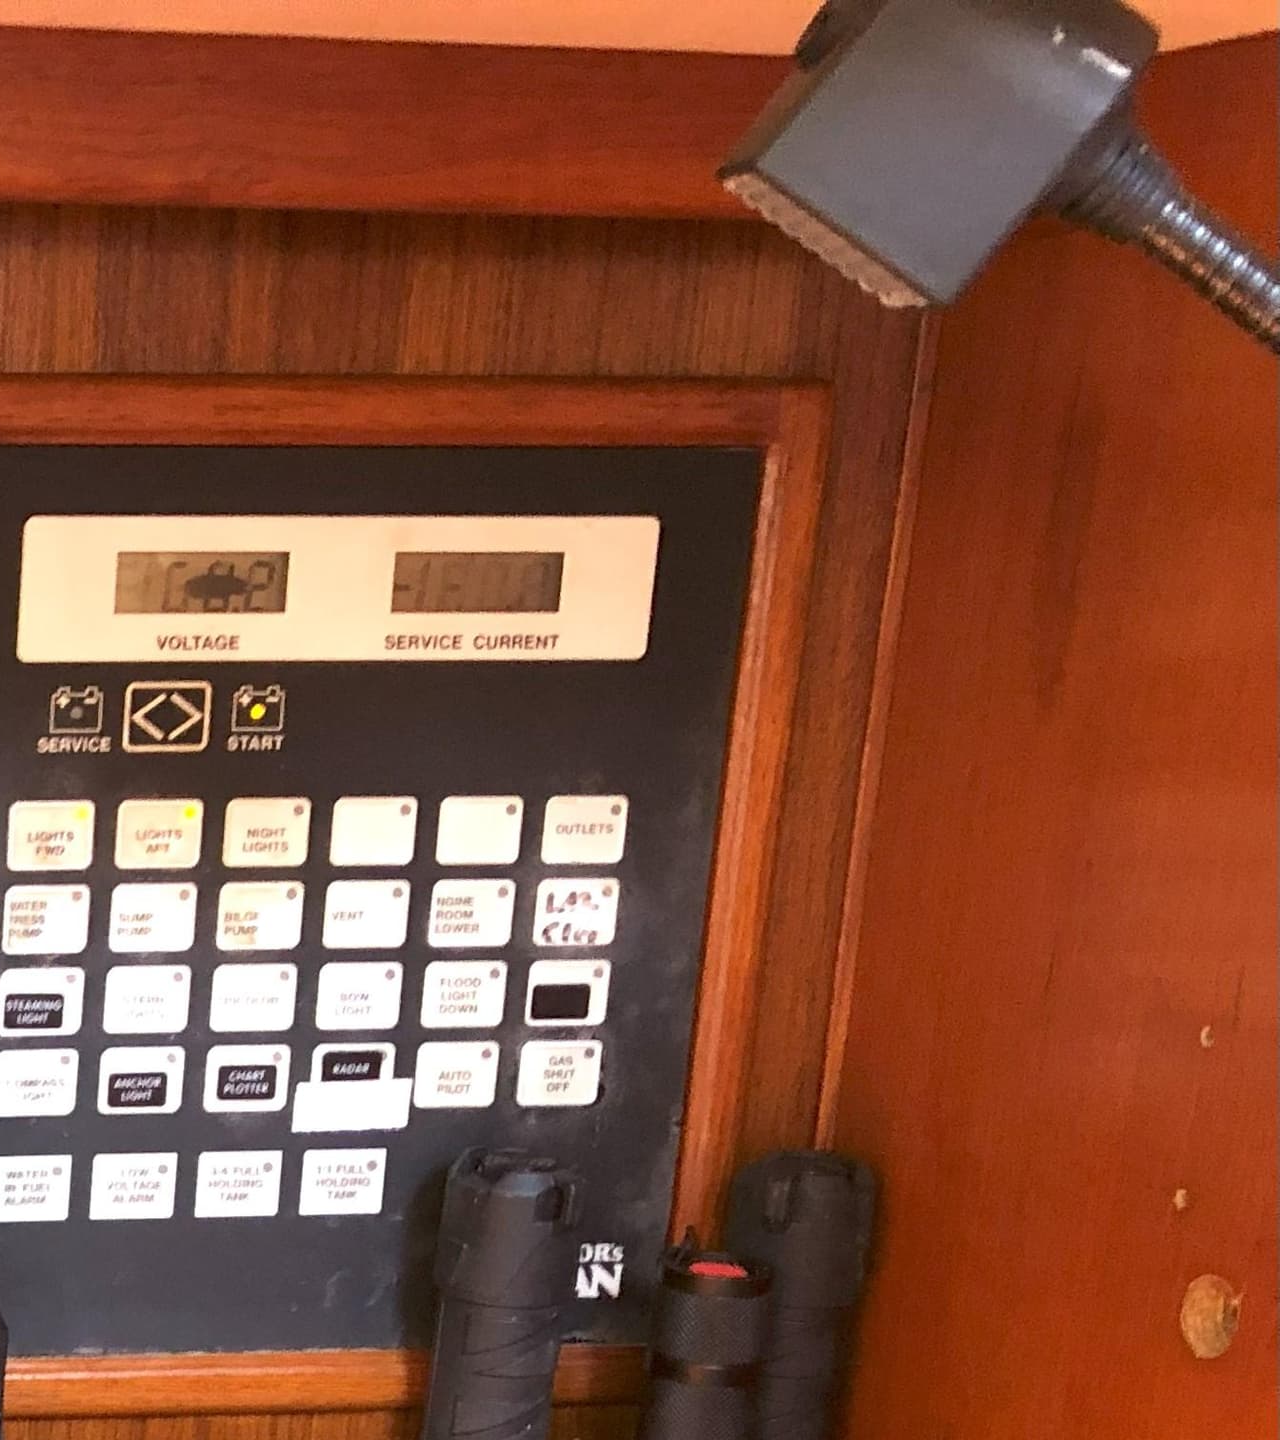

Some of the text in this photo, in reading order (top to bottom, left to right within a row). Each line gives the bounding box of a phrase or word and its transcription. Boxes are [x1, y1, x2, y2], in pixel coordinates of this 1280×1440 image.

[156, 634, 241, 651] VOLTAGE
[384, 634, 560, 651] SERVICE CURRENT
[37, 736, 112, 753] SERVICE
[227, 735, 285, 751] START
[246, 828, 287, 839] NIGHT
[555, 822, 614, 835] OUTLETS
[136, 829, 183, 841] LIGHTS
[242, 841, 290, 853] LIGHTS
[332, 911, 364, 921] VENT
[436, 909, 474, 920] ROOM
[434, 923, 480, 934] LOWER
[440, 977, 481, 988] FLOOD
[441, 991, 477, 1001] LIGHT
[439, 1004, 478, 1014] DOWN
[16, 1012, 49, 1025] LIGHT
[549, 1055, 573, 1067] GAS
[331, 1062, 370, 1075] RADAR
[544, 1068, 575, 1080] SHUT
[228, 1069, 266, 1082] CHART
[438, 1071, 472, 1082] AUTO
[114, 1076, 162, 1090] ANCHOR
[223, 1081, 269, 1095] PLOTTER
[546, 1081, 570, 1093] OFF
[437, 1084, 472, 1095] PILOT
[120, 1090, 152, 1103] LIGHT
[208, 1179, 263, 1189] HOLDING
[315, 1177, 371, 1188] HOLDING
